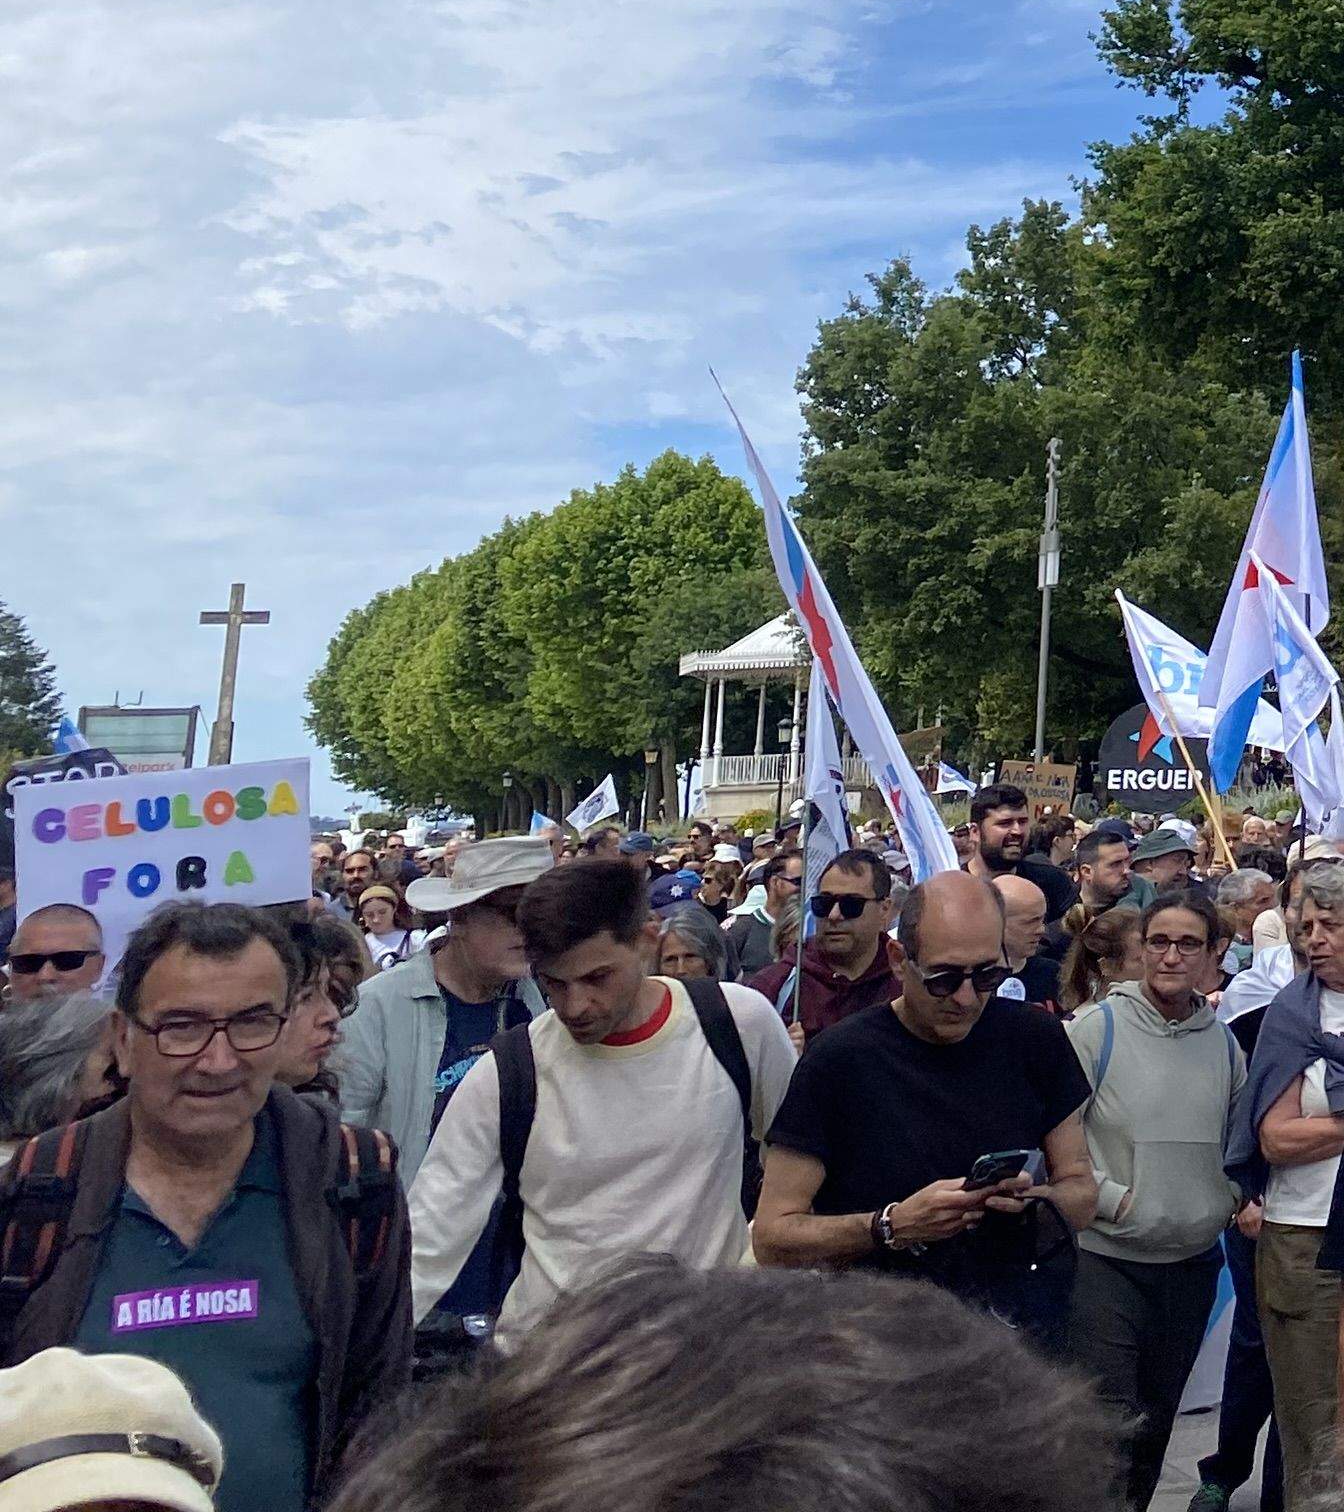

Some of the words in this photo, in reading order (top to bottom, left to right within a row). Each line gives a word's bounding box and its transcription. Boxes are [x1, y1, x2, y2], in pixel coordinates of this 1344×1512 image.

[32, 781, 300, 843] CELULOSA
[82, 850, 254, 905] FORA
[117, 1302, 132, 1327] A
[137, 1292, 175, 1324] RÍA
[180, 1289, 191, 1318] É
[196, 1288, 253, 1317] NOSA
